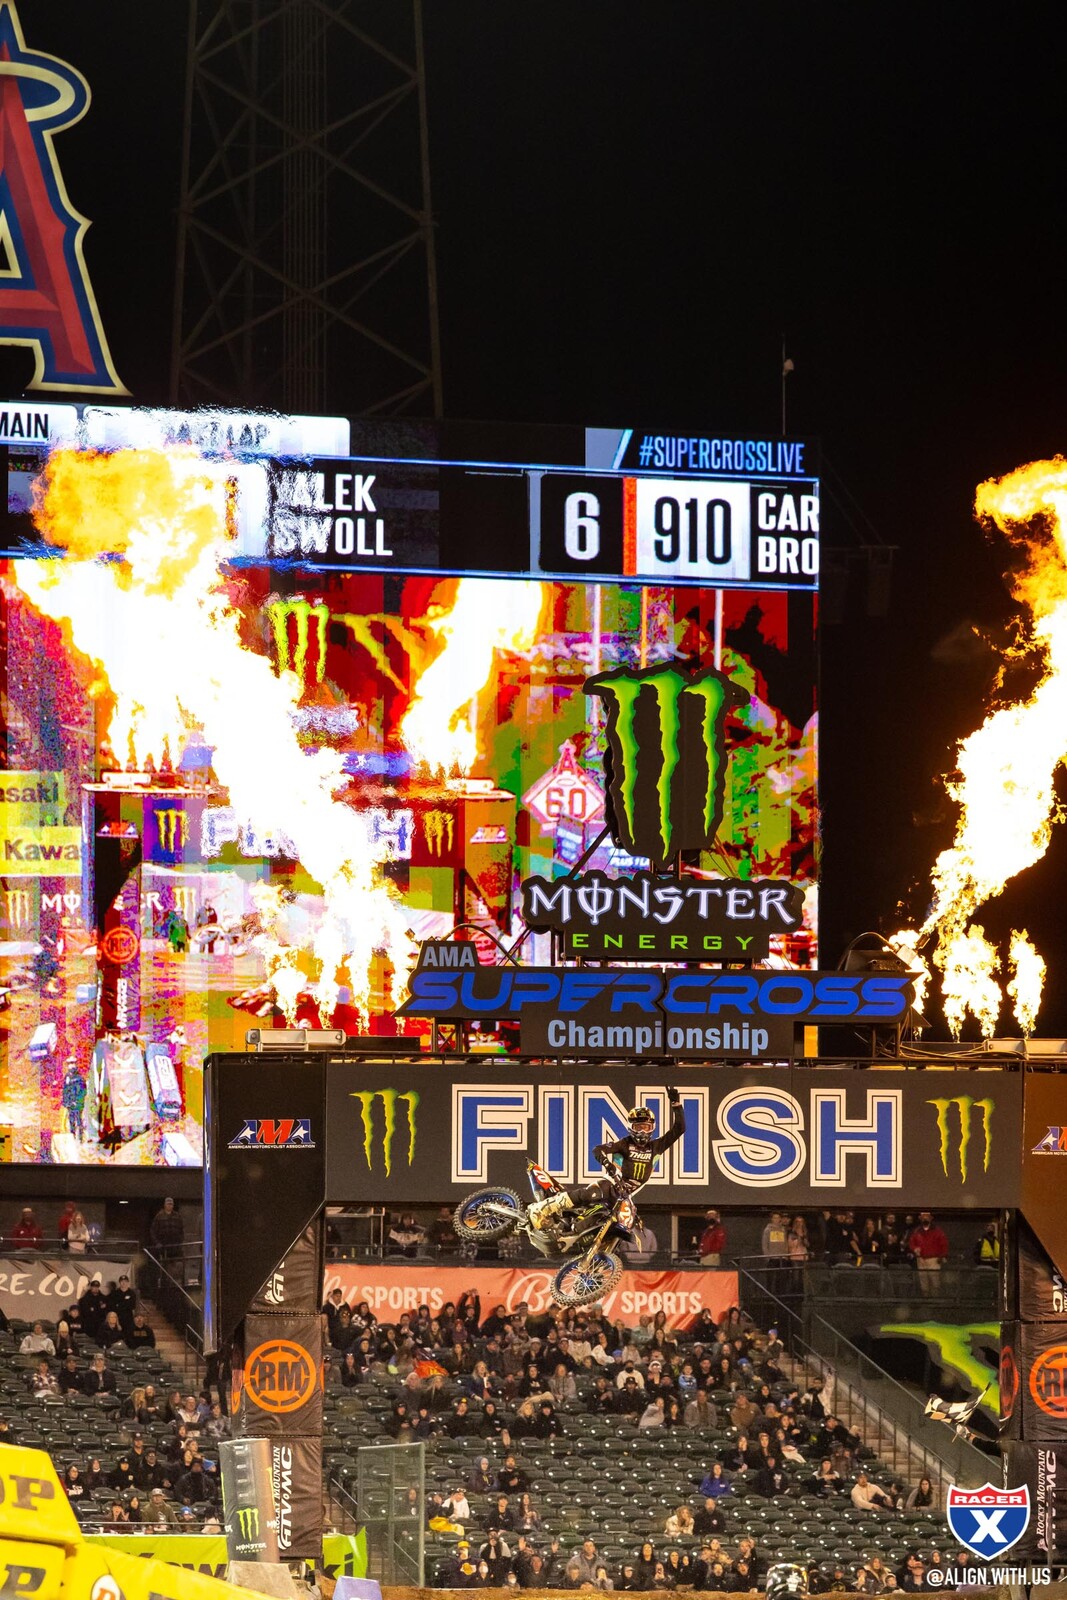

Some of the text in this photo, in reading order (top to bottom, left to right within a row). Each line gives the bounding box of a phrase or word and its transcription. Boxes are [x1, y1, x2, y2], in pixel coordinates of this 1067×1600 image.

[639, 435, 805, 473] #SUPERCROSSLIVE
[273, 469, 377, 513] ALEK
[564, 491, 601, 561] 6
[654, 496, 732, 565] 910
[757, 493, 819, 532] CAR
[757, 536, 819, 575] BRO
[546, 788, 587, 819] 60
[530, 878, 796, 925] MONSTER
[422, 946, 475, 967] AMA
[572, 933, 754, 950] ENERGY
[406, 972, 909, 1017] SUPERCROSS
[547, 1019, 769, 1055] Championship
[227, 1119, 316, 1145] AMA
[451, 1083, 903, 1188] FINISH
[1031, 1126, 1067, 1151] A
[361, 1285, 444, 1311] SPORTS
[620, 1291, 702, 1315] SPORTS
[259, 1361, 302, 1391] RM
[0, 1474, 55, 1511] P
[1036, 1449, 1045, 1536] ROCKY MOUNTAIN
[236, 1542, 267, 1551] MONSTER
